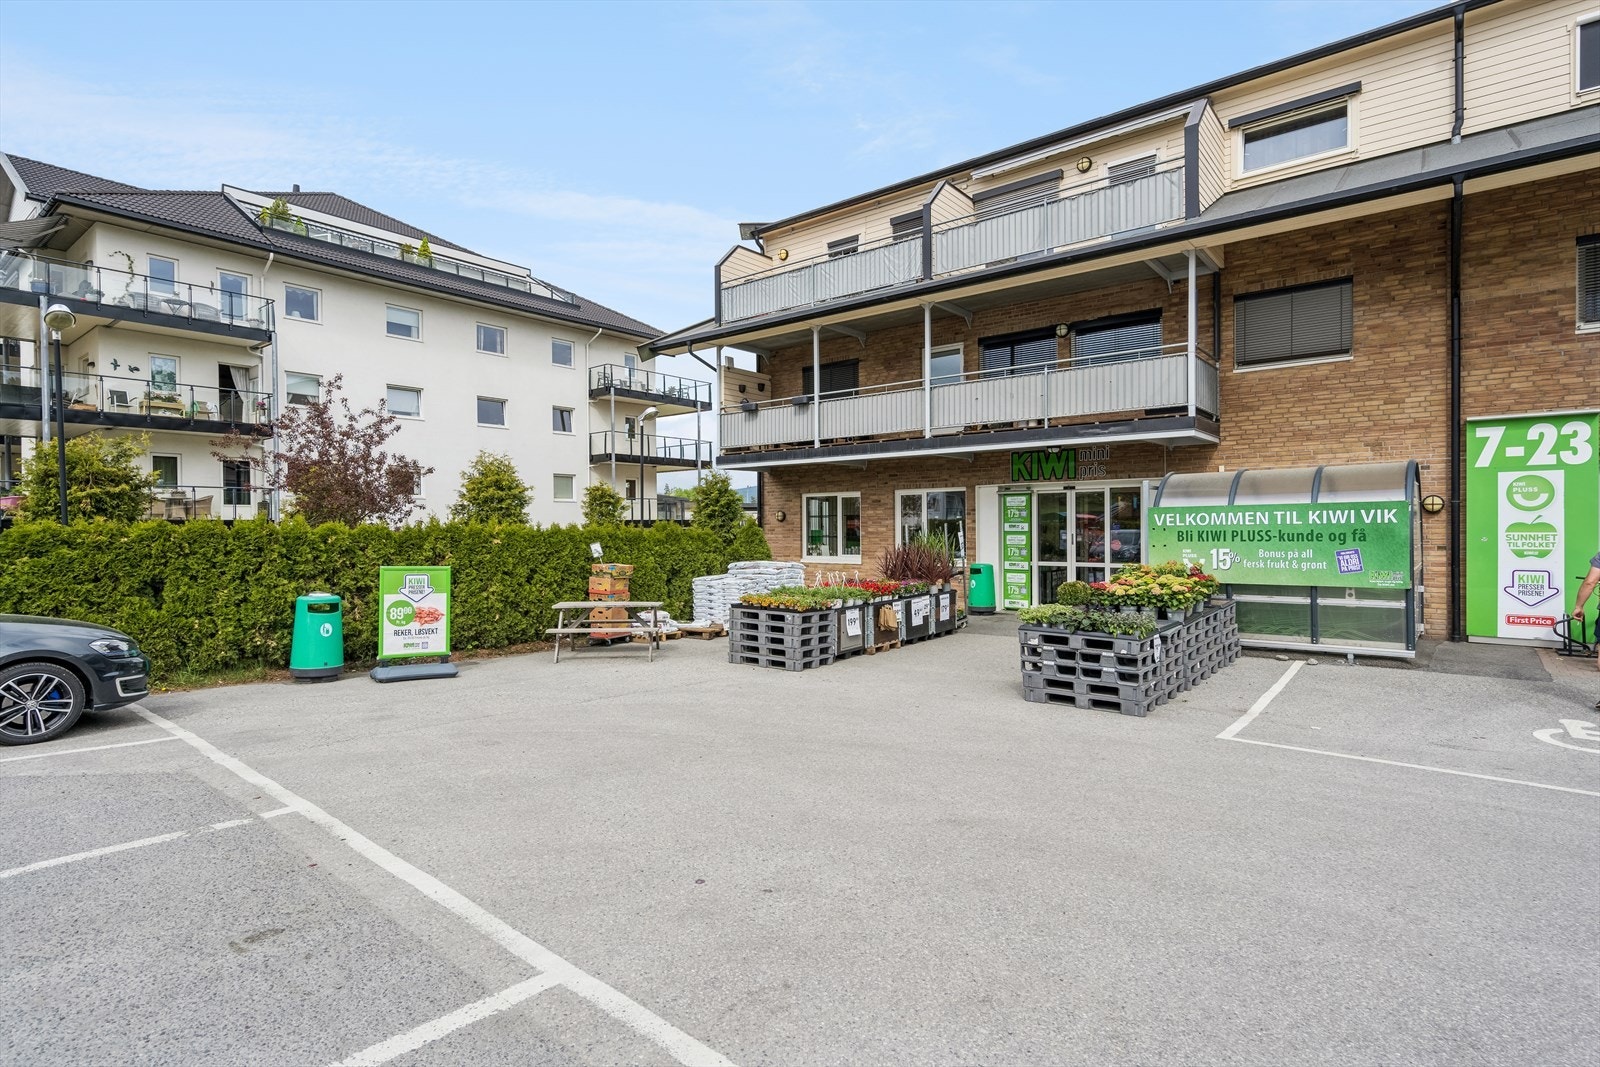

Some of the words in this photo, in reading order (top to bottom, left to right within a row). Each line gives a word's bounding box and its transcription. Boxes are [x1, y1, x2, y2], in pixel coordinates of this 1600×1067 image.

[1475, 421, 1592, 467] 7-23
[1011, 449, 1076, 481] KIWI
[1079, 445, 1110, 461] mini
[1079, 462, 1106, 480] pris
[1154, 511, 1269, 526] VELKOMMEN
[1274, 510, 1302, 525] TIL
[1308, 509, 1355, 524] KIWI
[1360, 508, 1398, 524] VIK
[1177, 530, 1193, 542] Bli
[1197, 530, 1226, 542] KIWI
[1231, 529, 1323, 542] PLUSS-kunde
[1328, 532, 1347, 545] og
[1351, 528, 1367, 542] få
[1210, 548, 1241, 570] 15%
[1258, 549, 1286, 558] Bonus
[1287, 550, 1300, 560] på
[1301, 549, 1313, 558] all
[1243, 559, 1265, 568] fersk
[1267, 560, 1290, 569] frukt
[1291, 561, 1299, 569] &
[1301, 561, 1327, 571] grønt
[1518, 574, 1544, 584] KIWI
[1509, 616, 1529, 624] First
[1530, 617, 1552, 625] Price
